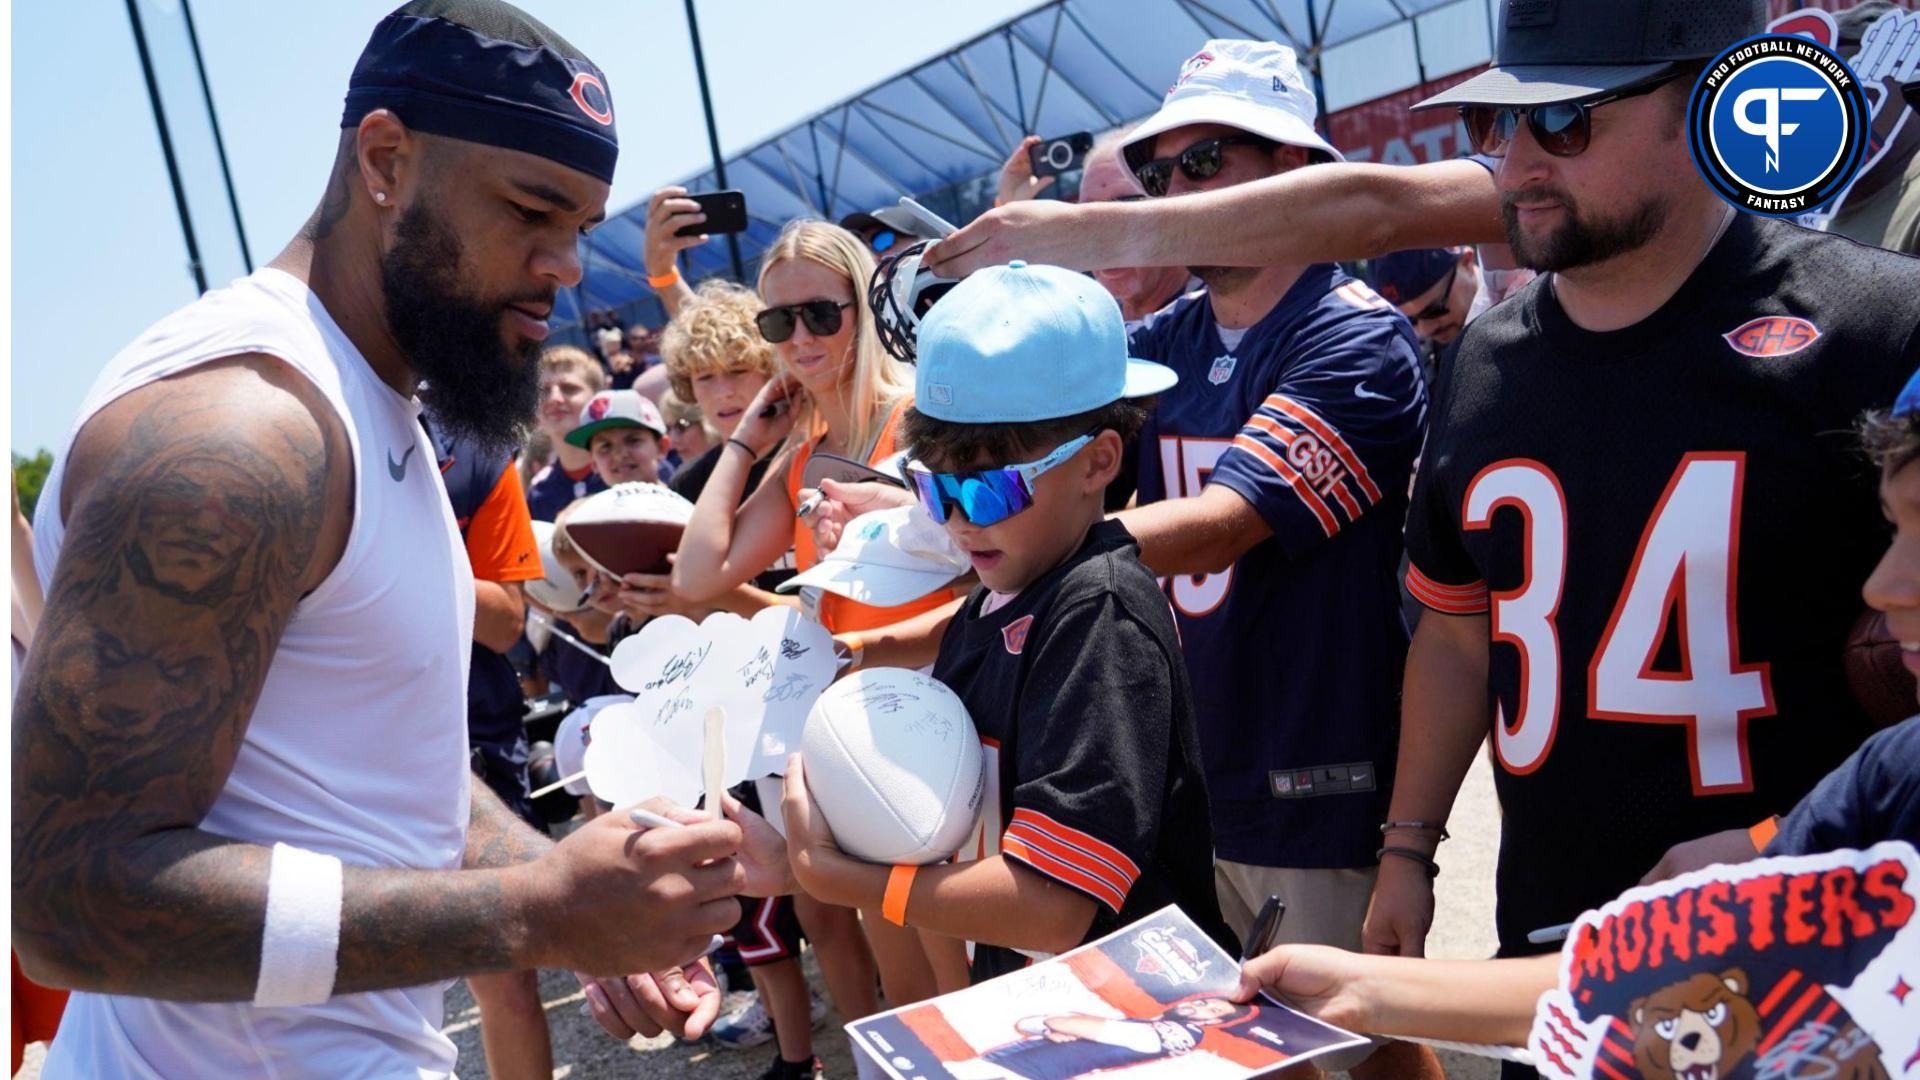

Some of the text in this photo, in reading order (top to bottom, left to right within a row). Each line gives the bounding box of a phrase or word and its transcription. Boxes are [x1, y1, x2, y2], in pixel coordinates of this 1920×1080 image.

[1731, 320, 1811, 353] GHS
[1286, 432, 1348, 499] GSH
[1461, 451, 1778, 797] 34
[1569, 859, 1916, 992] MONSTERS
